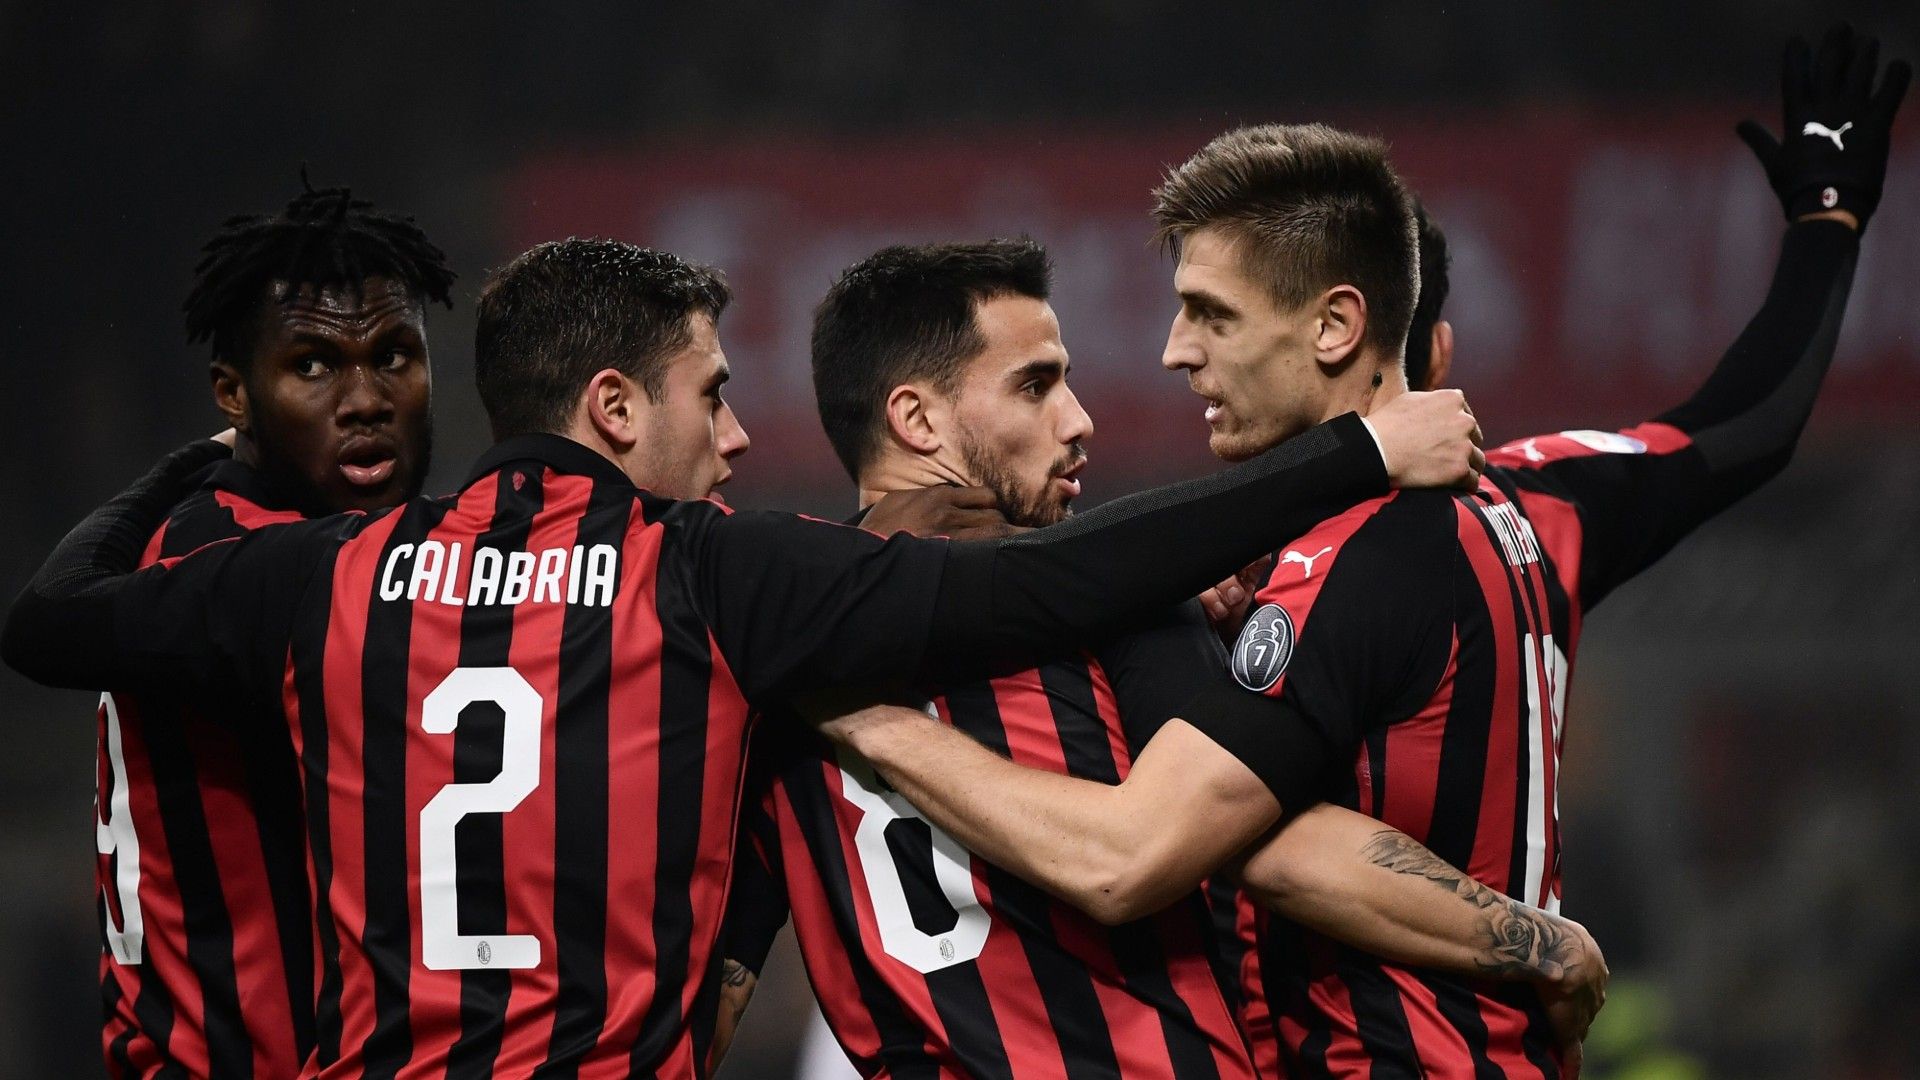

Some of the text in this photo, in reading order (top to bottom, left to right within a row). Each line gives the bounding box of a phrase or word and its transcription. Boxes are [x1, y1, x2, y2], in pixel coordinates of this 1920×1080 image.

[379, 540, 617, 607] CALABRIA
[1254, 644, 1268, 667] 7
[420, 667, 544, 970] 2
